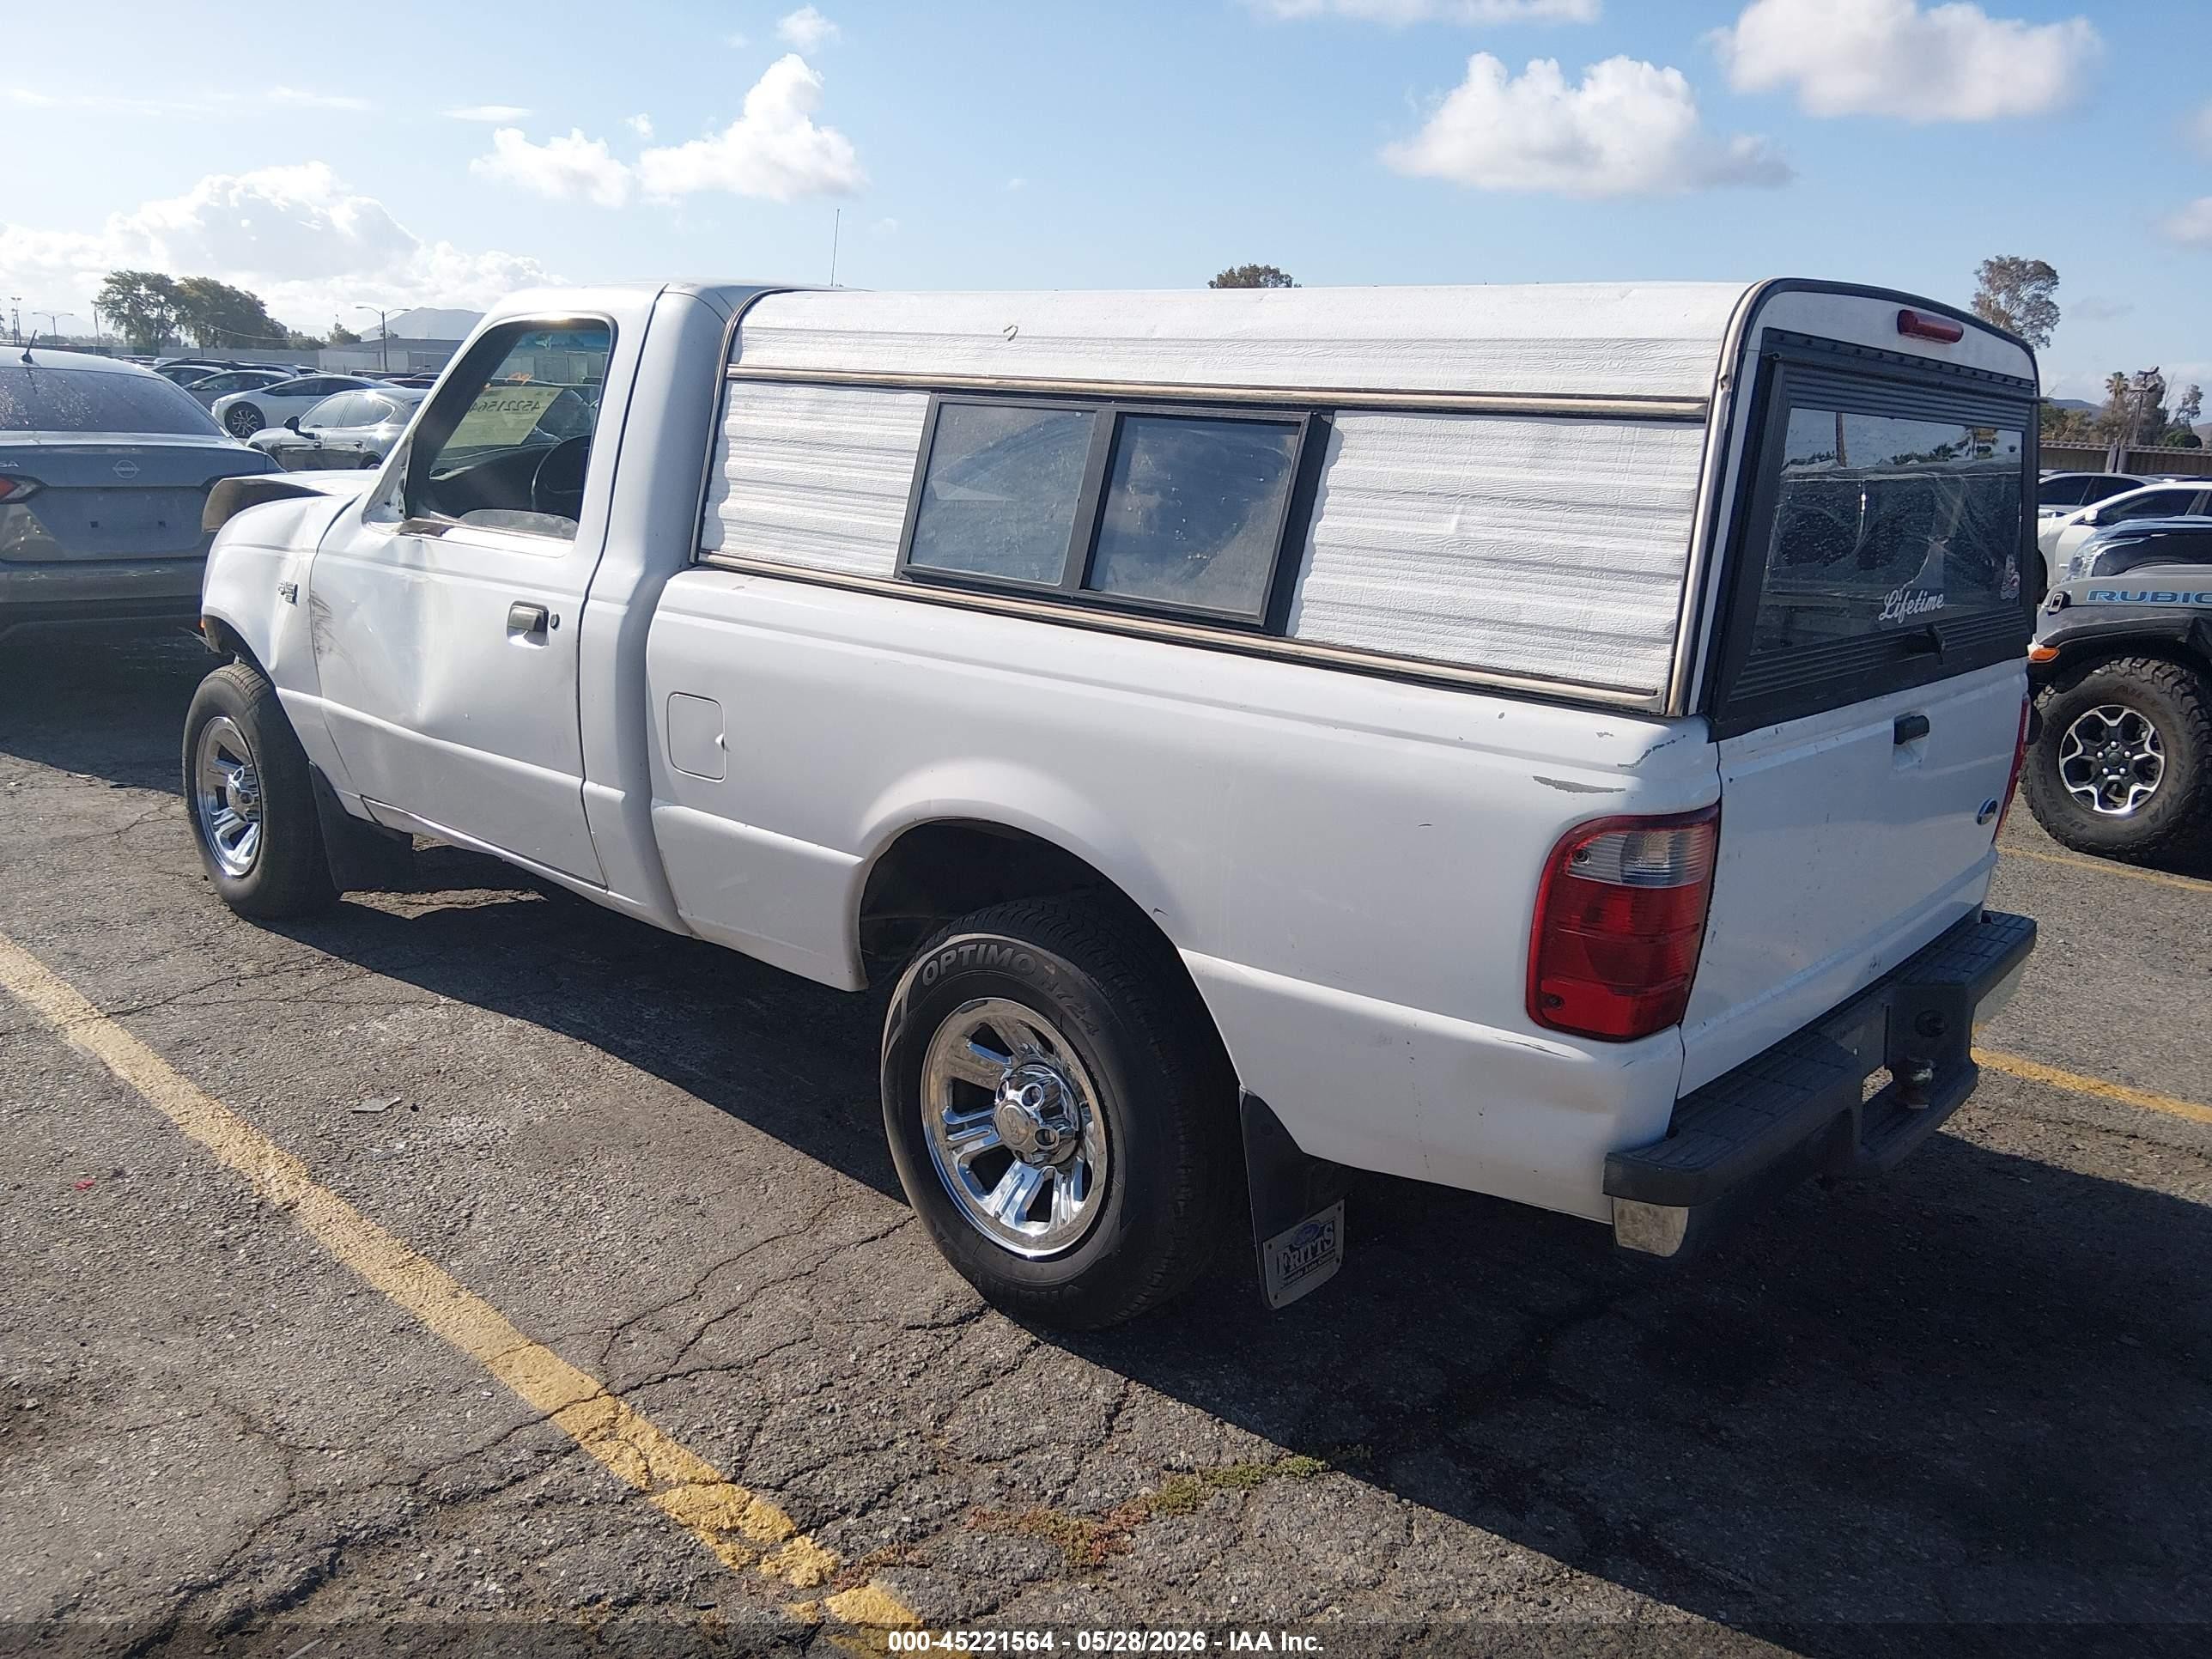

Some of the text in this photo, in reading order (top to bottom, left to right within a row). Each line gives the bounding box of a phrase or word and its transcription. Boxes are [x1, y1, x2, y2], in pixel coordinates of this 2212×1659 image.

[1878, 588, 1945, 624] Lifetime
[921, 943, 1036, 987] OPTIMO
[1277, 1221, 1334, 1276] FRITTS
